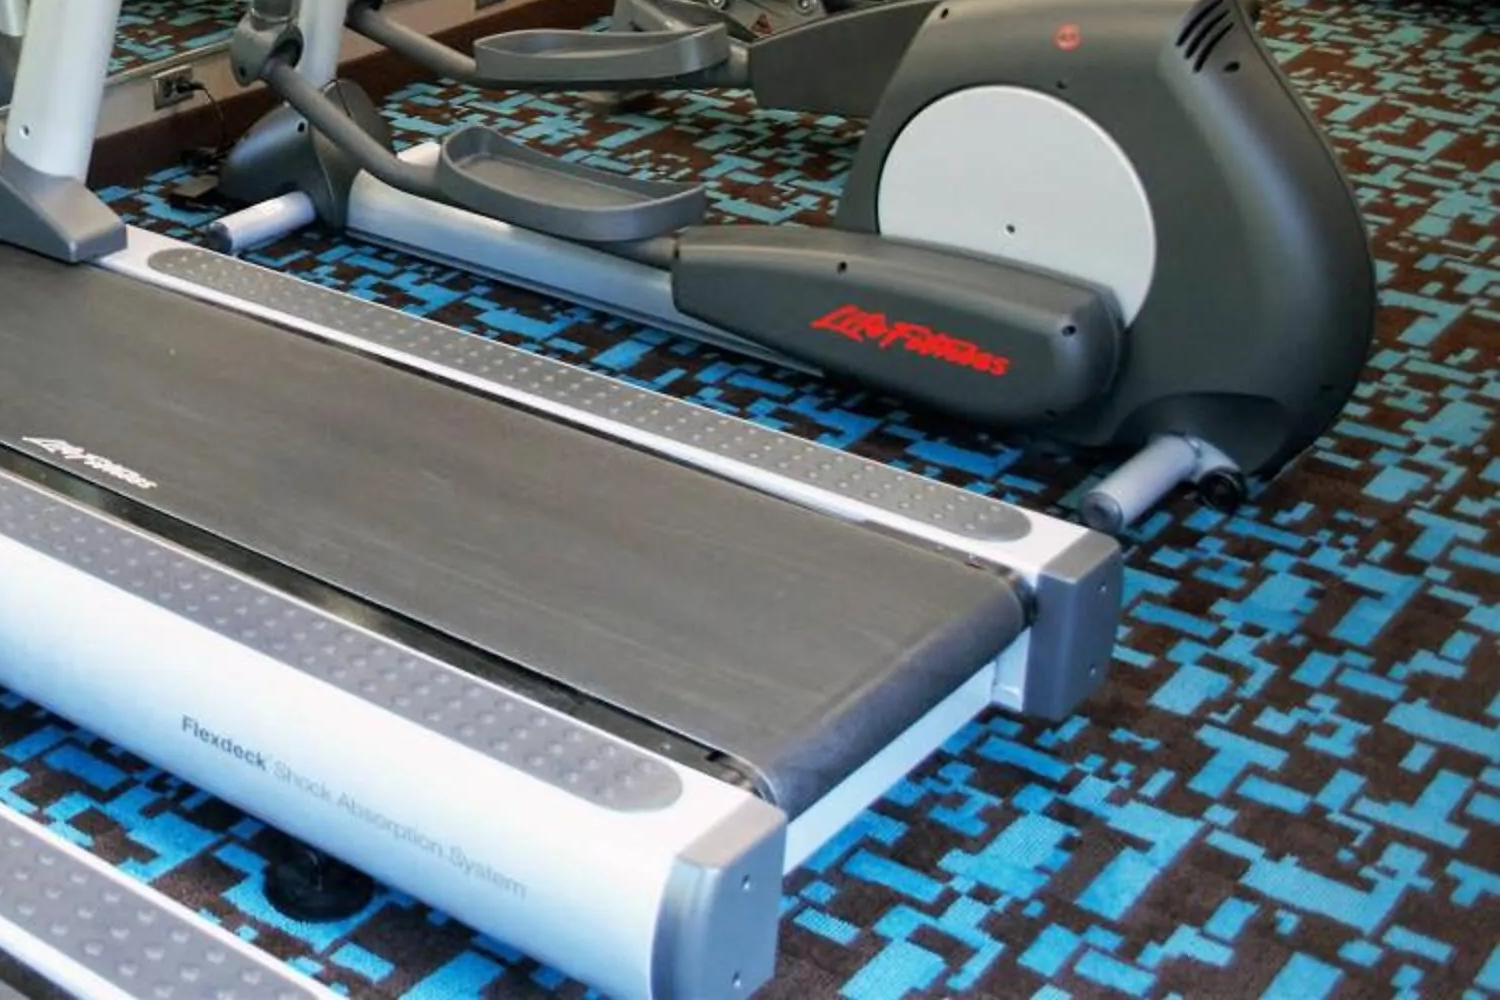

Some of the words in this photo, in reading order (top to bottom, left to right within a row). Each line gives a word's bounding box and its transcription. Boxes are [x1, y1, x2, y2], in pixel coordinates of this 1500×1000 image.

[809, 303, 889, 343] Life
[878, 320, 1011, 376] Fitness
[181, 714, 267, 772] Flexdeck
[273, 760, 332, 801] Shock
[337, 791, 444, 858] Absorption
[449, 846, 527, 899] System
